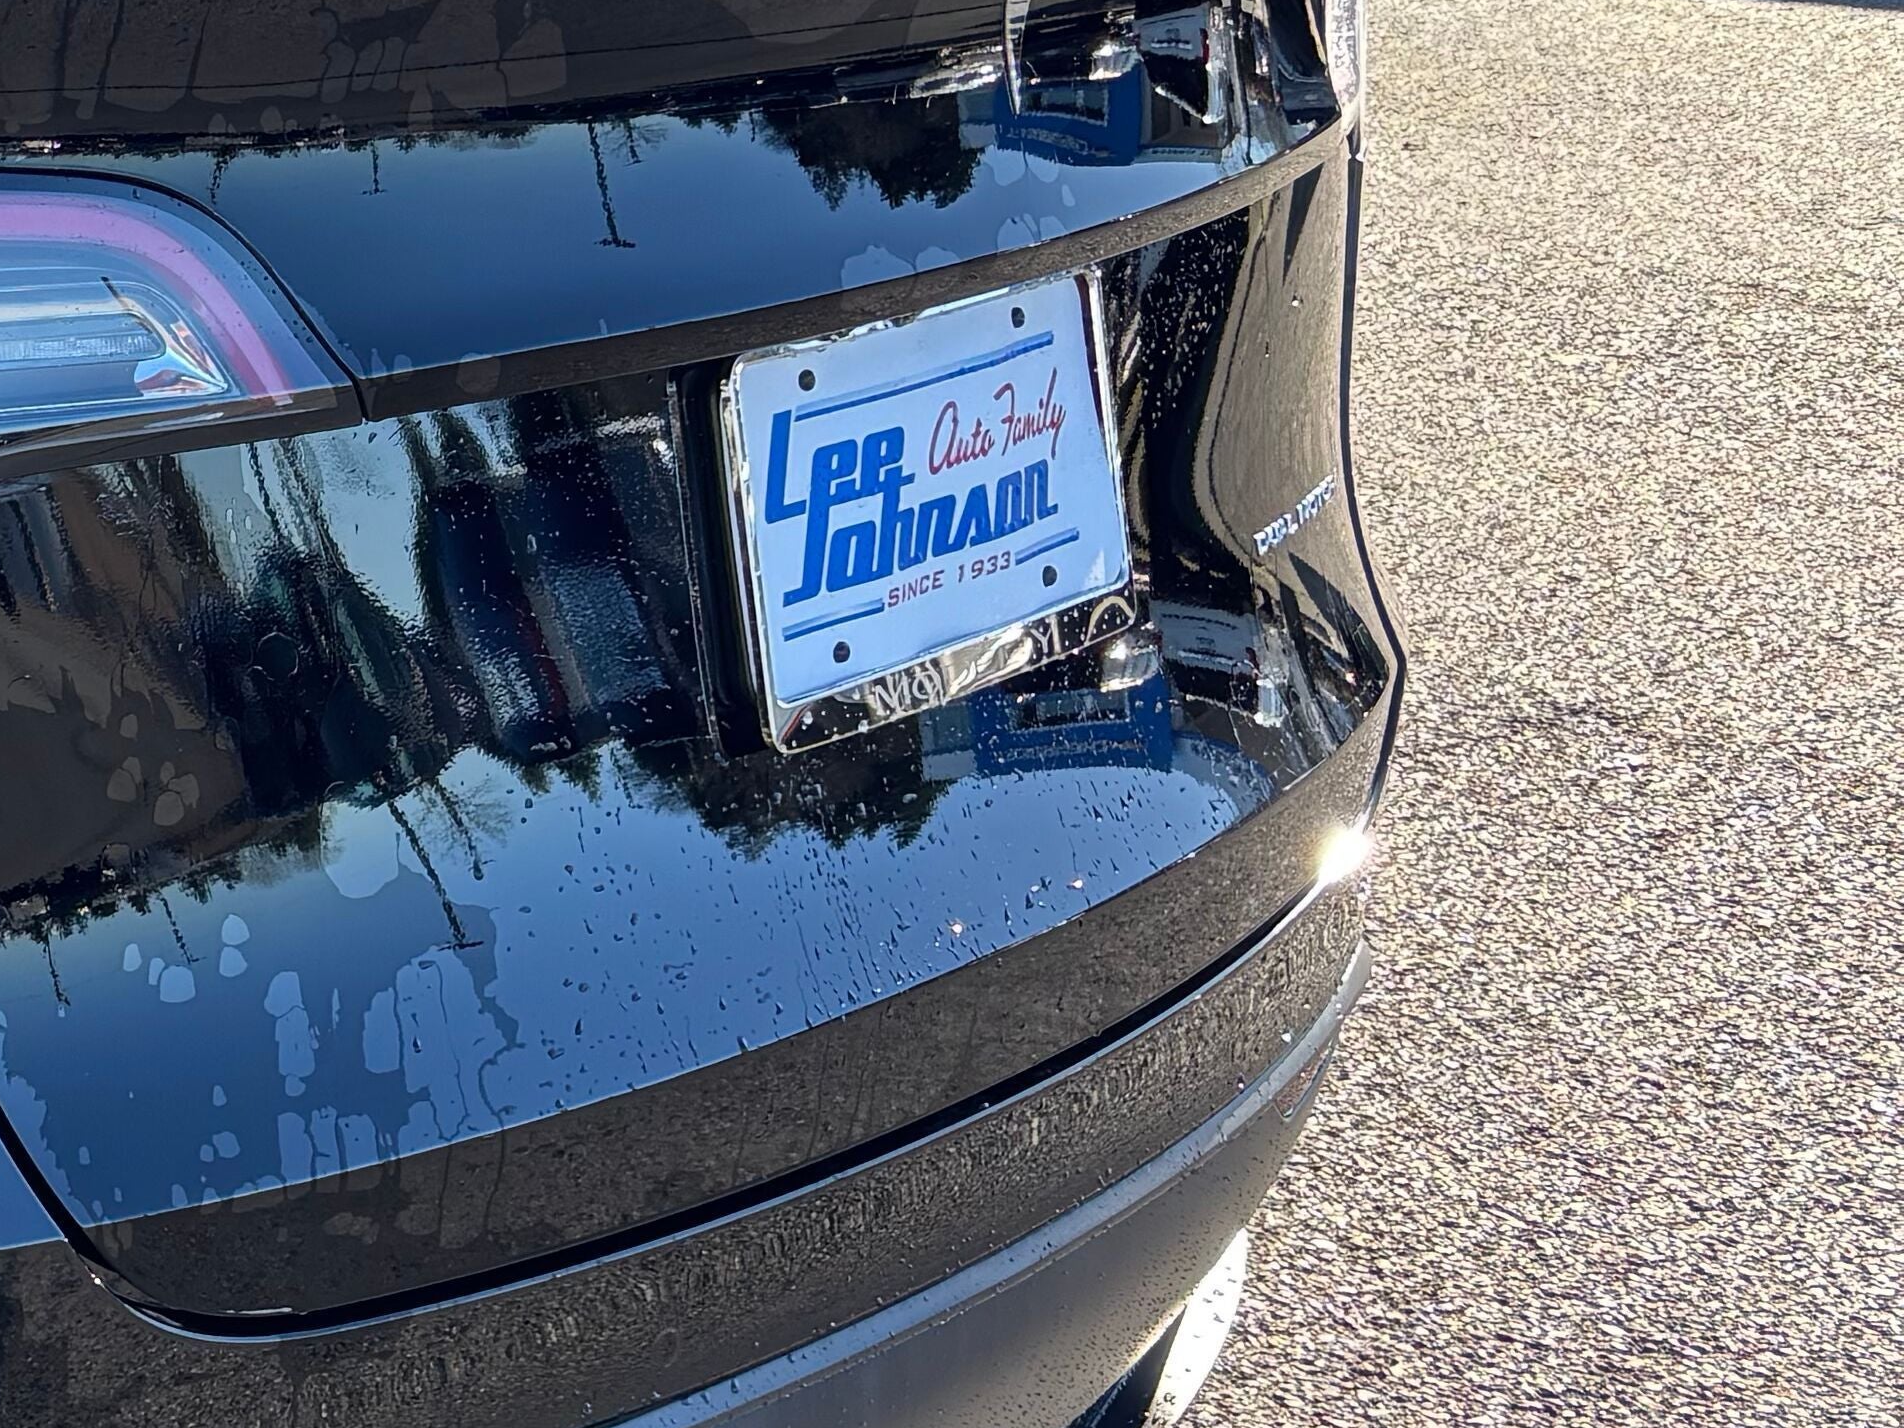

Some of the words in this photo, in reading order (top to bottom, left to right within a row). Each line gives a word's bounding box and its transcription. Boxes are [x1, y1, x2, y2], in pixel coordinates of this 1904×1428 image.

[765, 409, 905, 525] Lee
[928, 400, 996, 476] Auto
[993, 367, 1067, 460] Family
[783, 459, 1059, 608] Johnson
[887, 569, 945, 608] SINCE
[958, 551, 1011, 583] 1933
